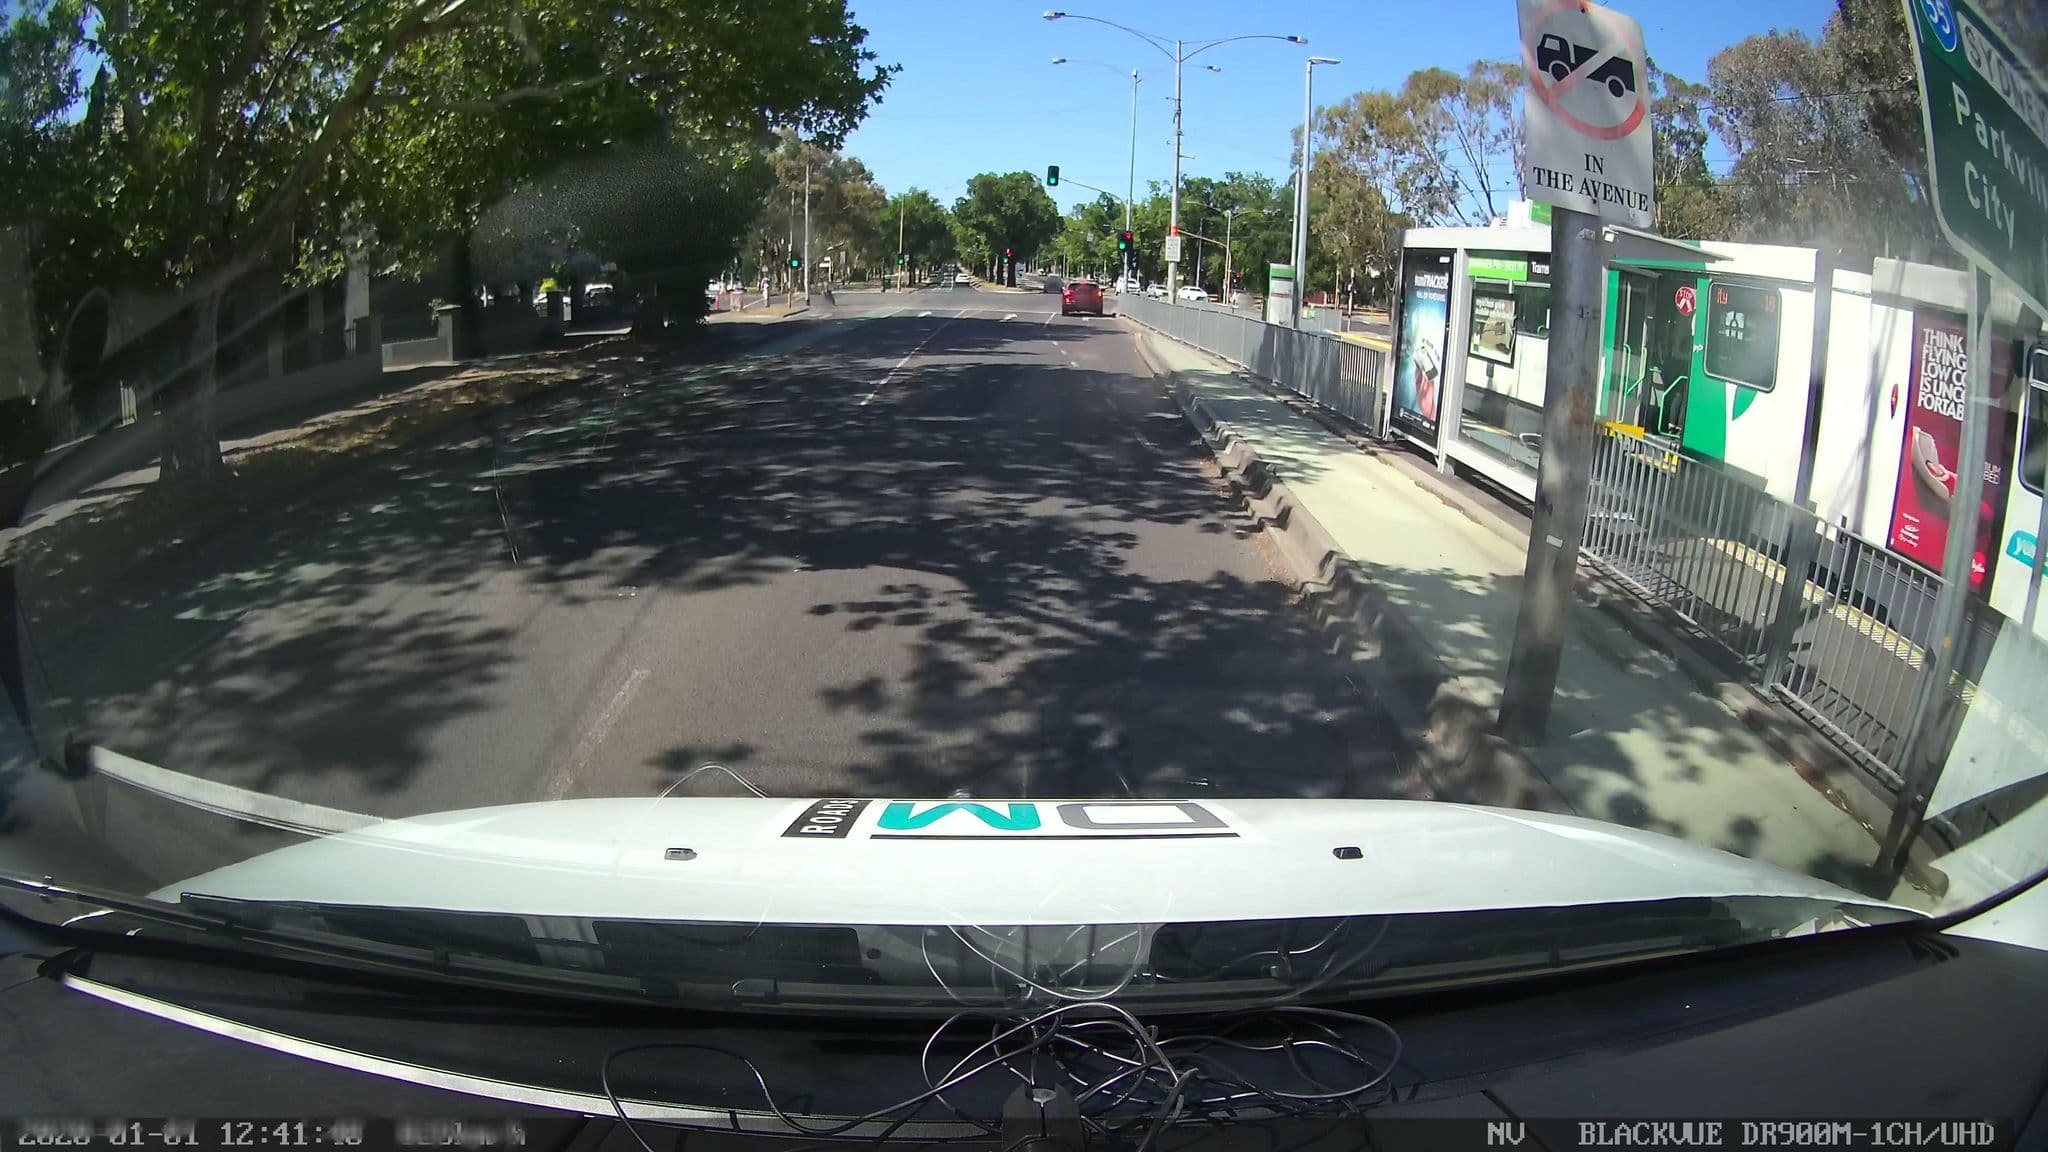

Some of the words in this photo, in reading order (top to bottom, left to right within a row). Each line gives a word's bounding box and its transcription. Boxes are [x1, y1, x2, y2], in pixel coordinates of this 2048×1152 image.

[1584, 153, 1604, 175] IN
[1533, 166, 1573, 192] THE
[1579, 178, 1648, 212] AVENUE
[1964, 161, 2015, 249] City
[1678, 289, 1693, 299] STOP
[1923, 328, 1963, 353] THINK
[1922, 344, 1968, 370] FLYING
[1921, 360, 1952, 381] LOW
[1920, 375, 1932, 393] IS
[1932, 379, 1966, 404] UNC
[800, 799, 860, 834] ROADS
